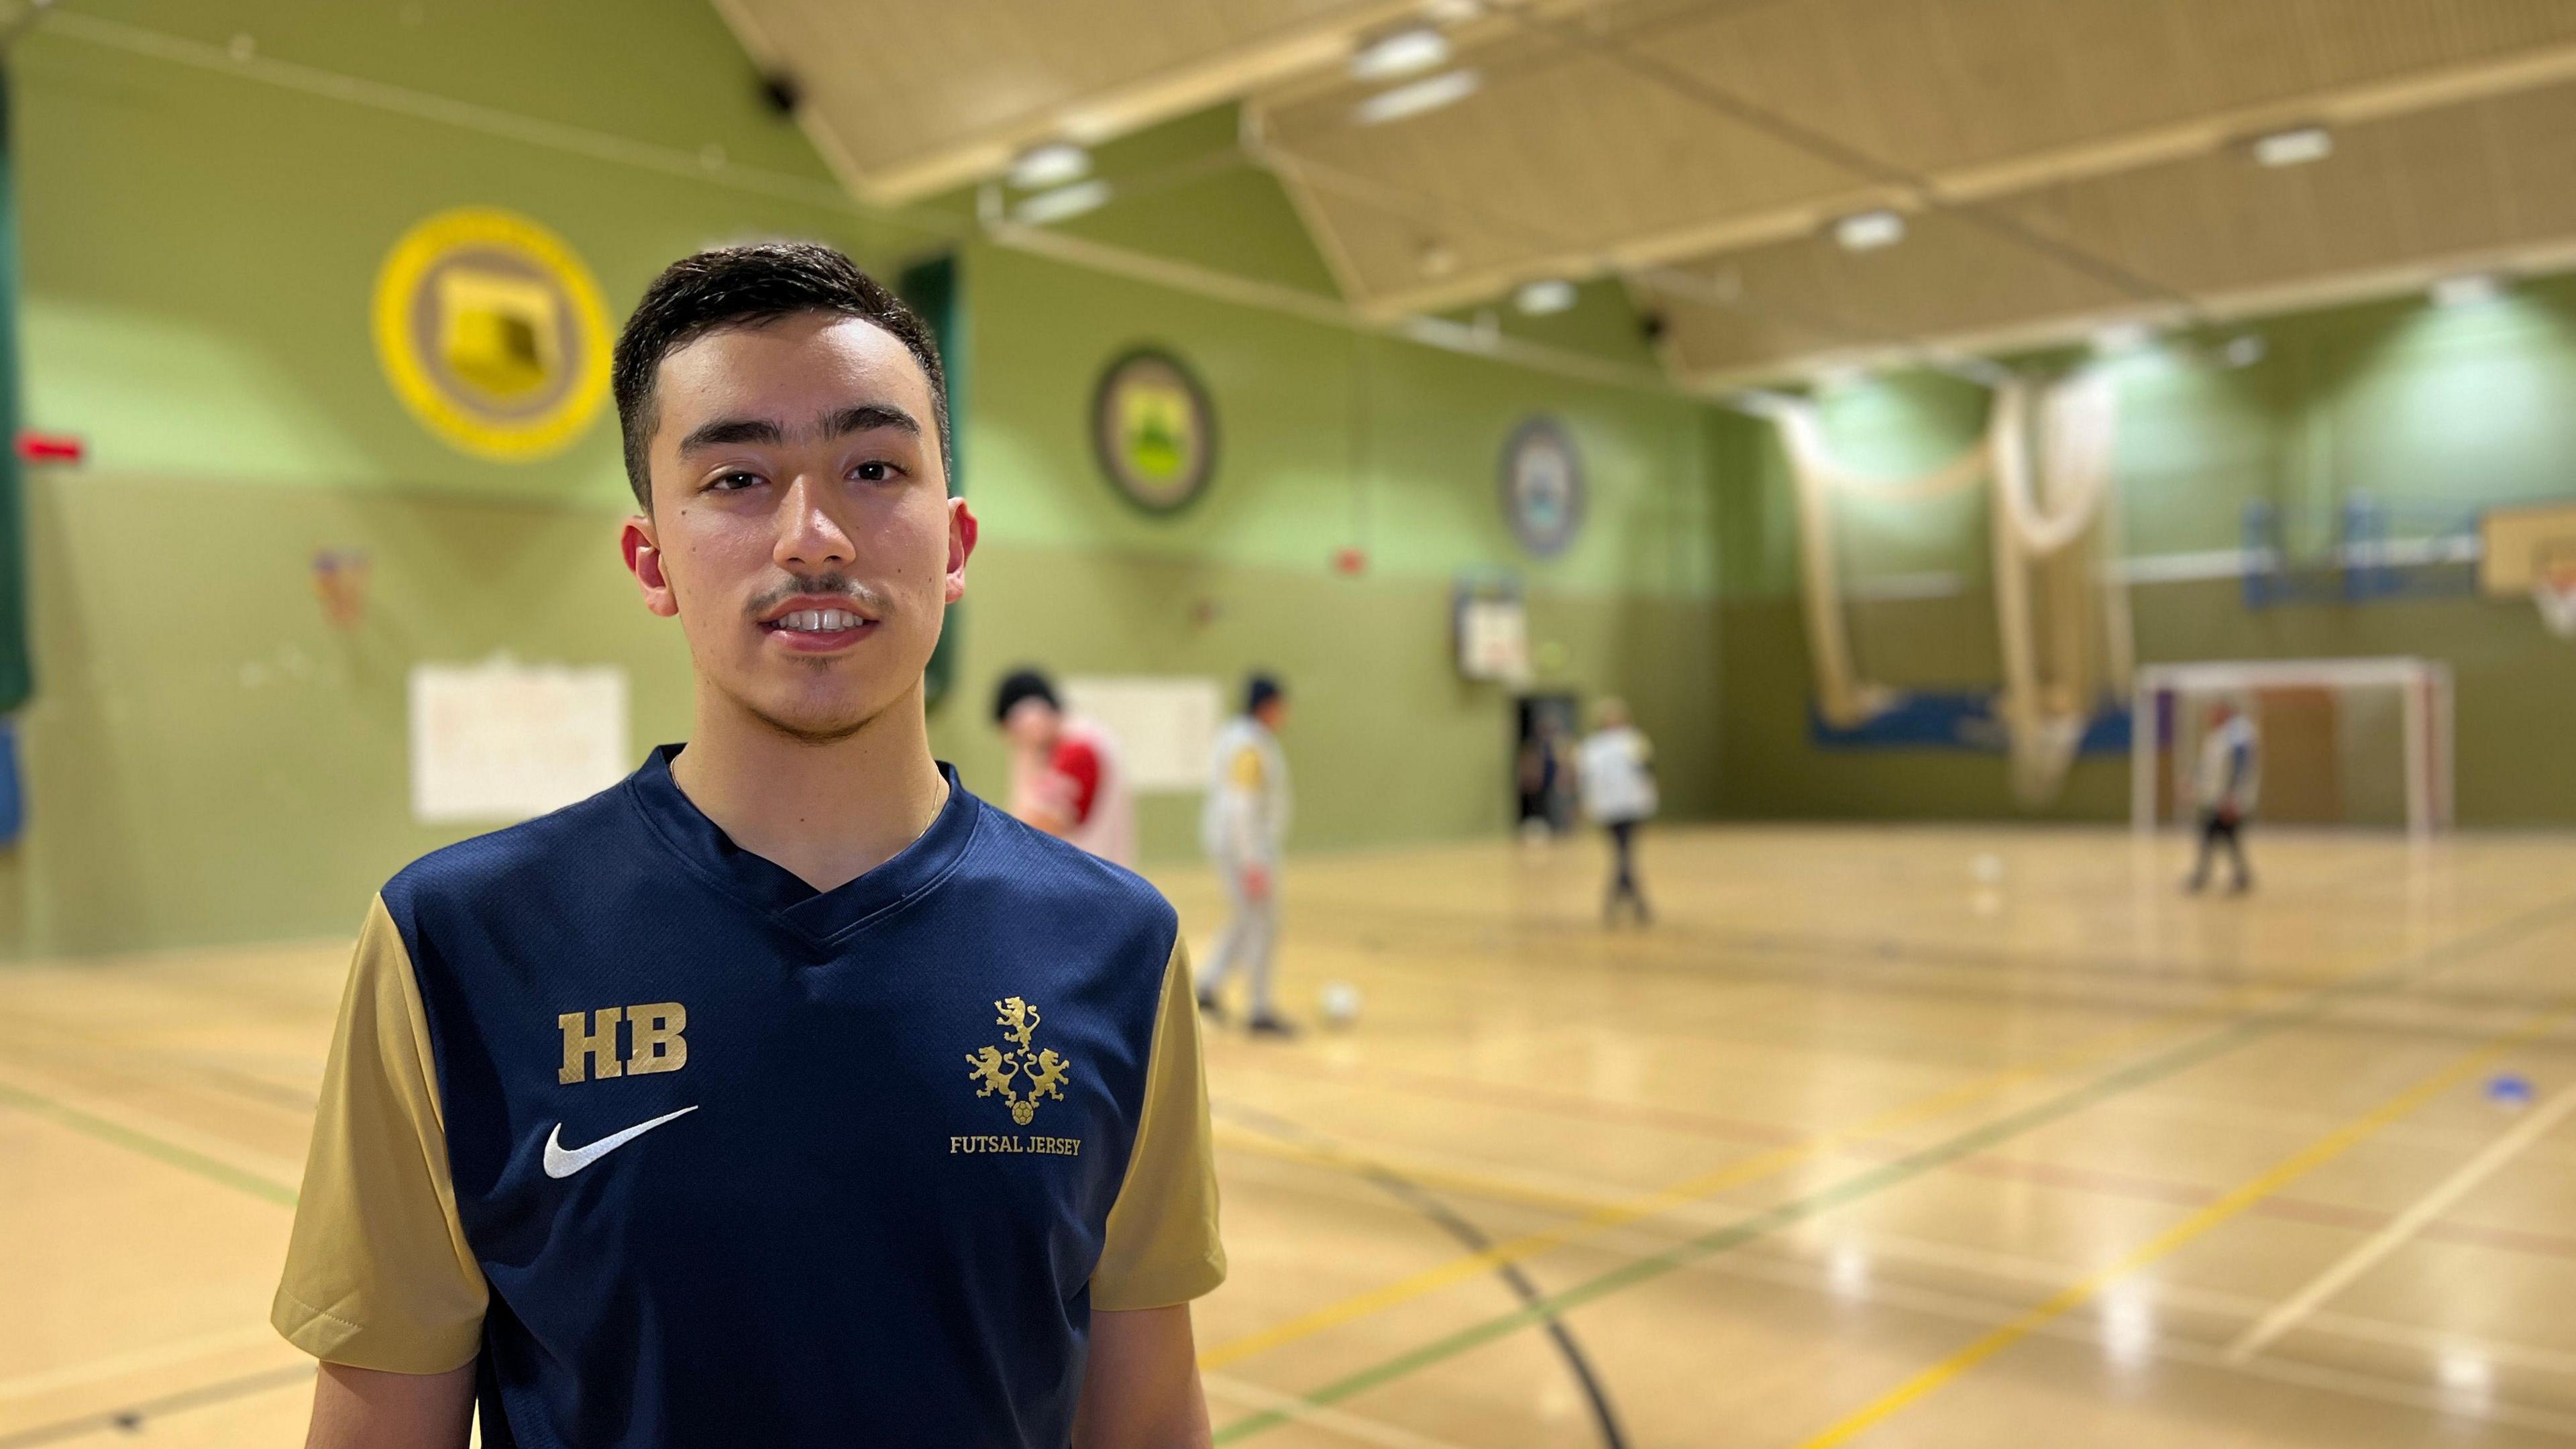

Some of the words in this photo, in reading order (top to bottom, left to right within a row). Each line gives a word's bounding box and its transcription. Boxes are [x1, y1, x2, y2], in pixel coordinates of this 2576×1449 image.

[558, 1002, 687, 1085] HB
[950, 1135, 1023, 1154] FUTSAL
[1026, 1136, 1081, 1156] JERSEY
